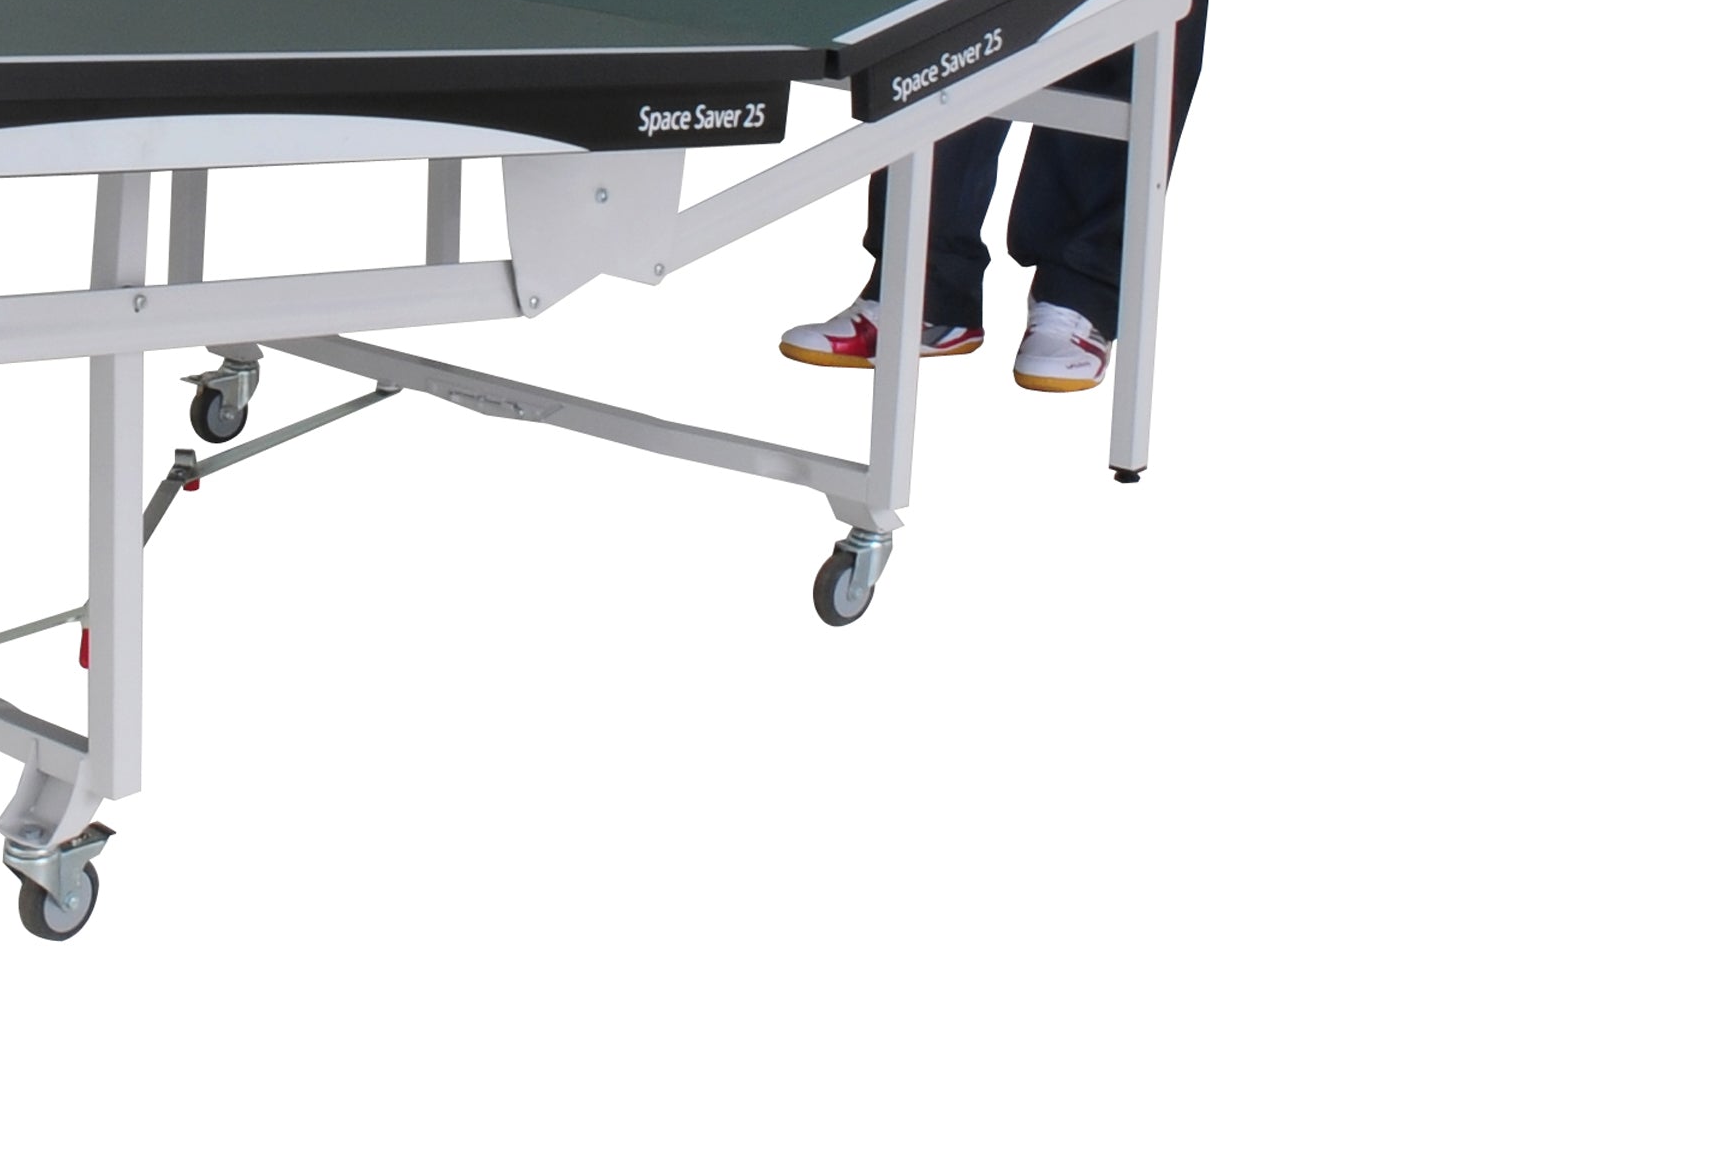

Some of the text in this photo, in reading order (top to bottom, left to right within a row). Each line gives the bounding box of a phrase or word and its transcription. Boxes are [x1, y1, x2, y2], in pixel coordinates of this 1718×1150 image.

[892, 28, 1003, 102] Space Saver 25
[638, 103, 766, 137] Space Saver 25
